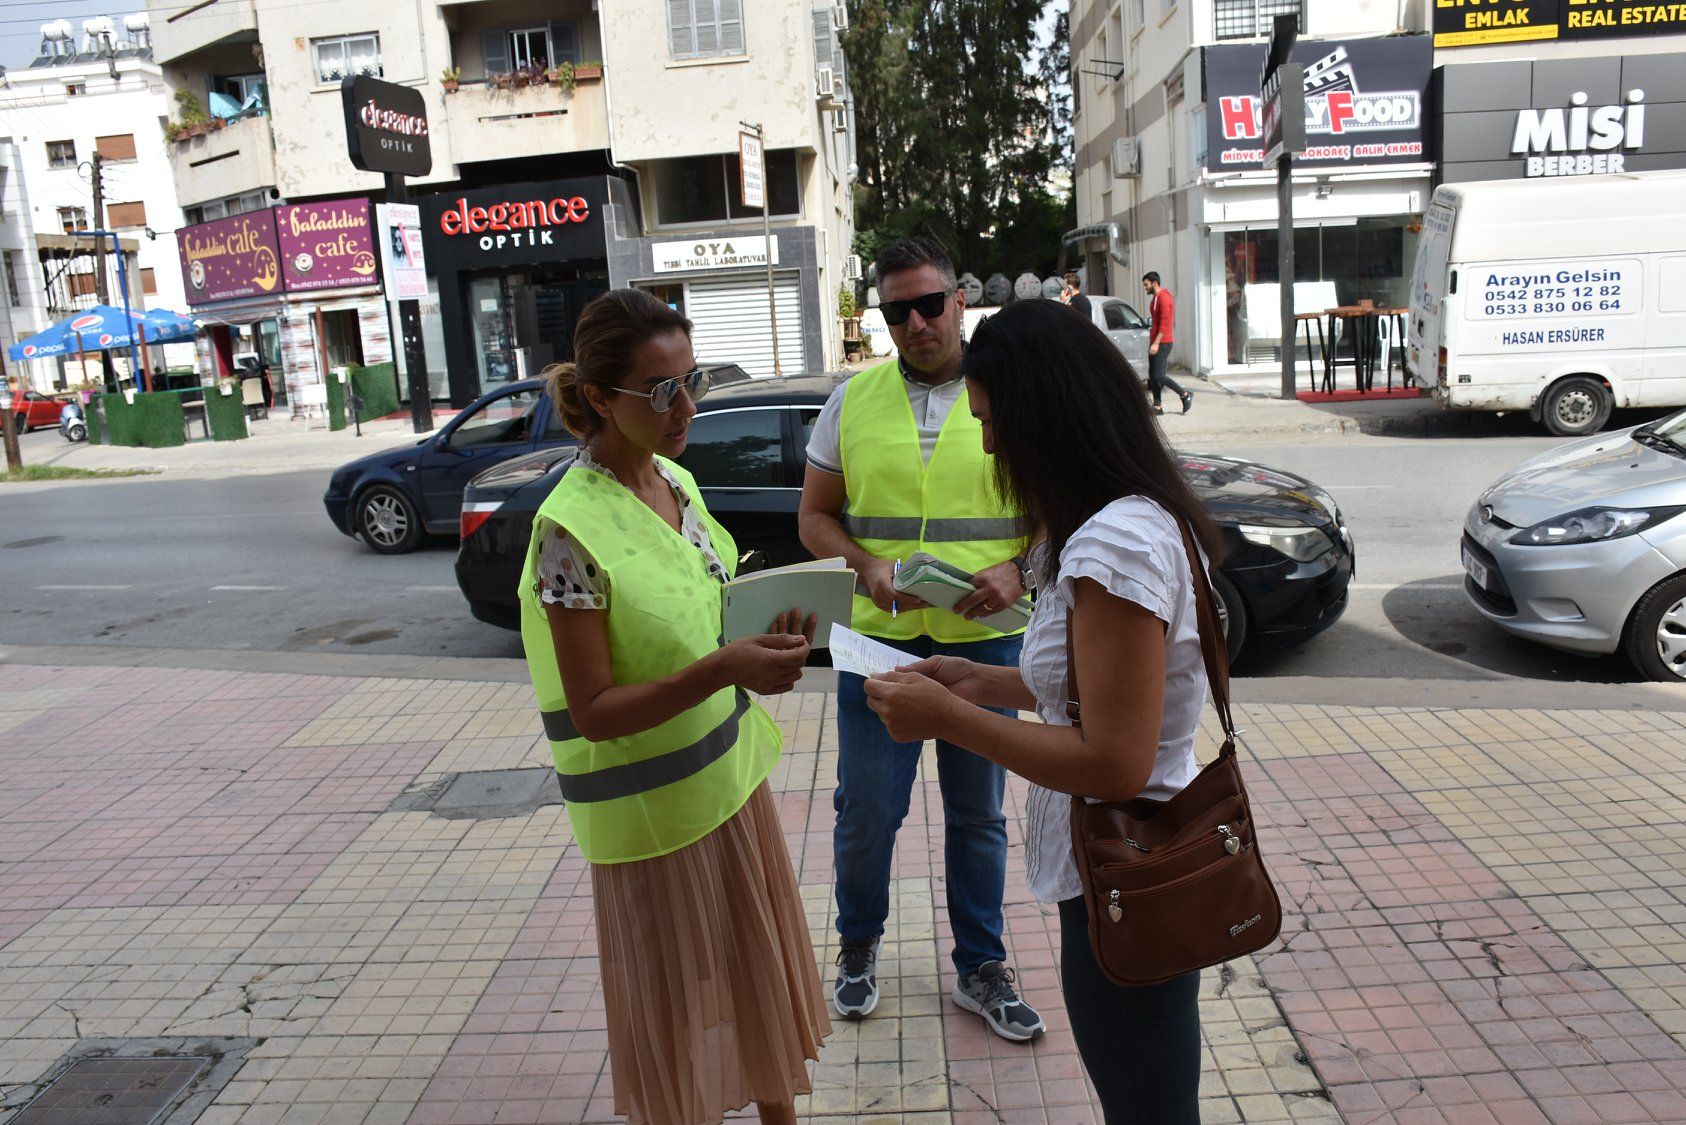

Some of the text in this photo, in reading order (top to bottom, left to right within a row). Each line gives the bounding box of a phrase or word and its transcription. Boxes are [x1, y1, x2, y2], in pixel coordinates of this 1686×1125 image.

[1465, 8, 1529, 29] EMLAK
[1568, 4, 1686, 28] REAL ESTATE
[361, 99, 428, 136] elegance
[381, 138, 413, 153] OPTİK
[1223, 149, 1254, 162] MİDYE
[1355, 144, 1383, 155] BALIK
[1387, 143, 1422, 154] EKMEK
[1527, 153, 1625, 177] BERBER
[440, 196, 590, 236] elegance
[227, 219, 260, 256] cafe
[315, 233, 359, 258] cafe
[479, 229, 554, 251] OPTİK
[693, 242, 736, 257] OYA
[1485, 269, 1621, 288] Arayın Gelsin
[1485, 285, 1621, 302] 0542 875 12 82
[1485, 299, 1621, 315] 0533 830 06 64
[1502, 327, 1605, 345] HASAN ERSÜRER
[38, 342, 66, 355] pepsi
